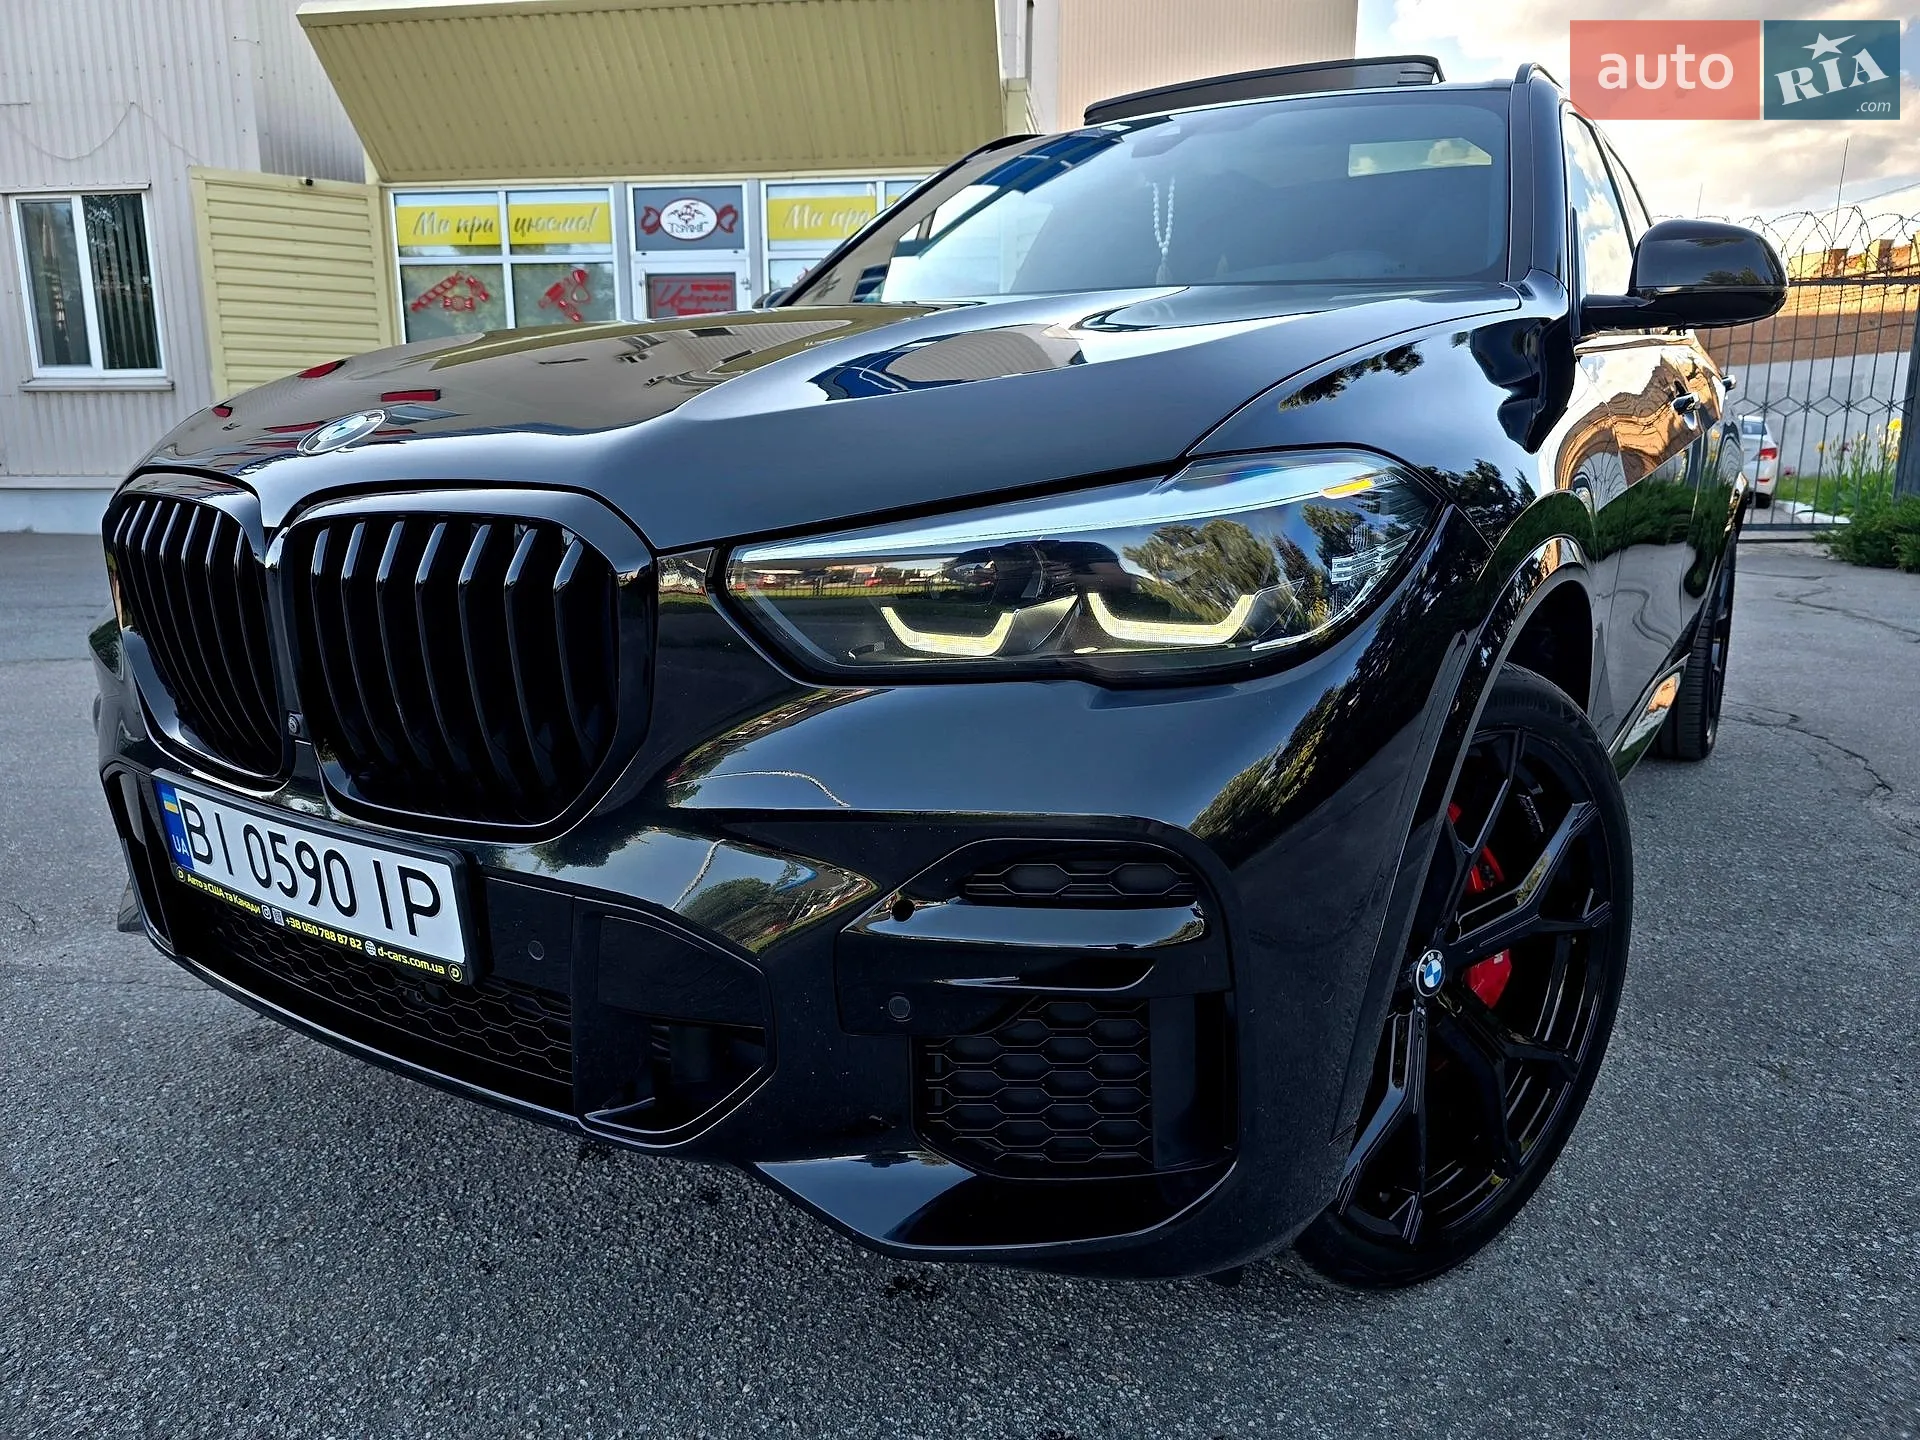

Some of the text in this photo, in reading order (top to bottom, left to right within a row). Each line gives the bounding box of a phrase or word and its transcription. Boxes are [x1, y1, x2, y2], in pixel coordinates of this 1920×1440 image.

[172, 834, 190, 857] UA
[179, 798, 441, 938] BI 0590 IP
[187, 874, 203, 888] Авто
[207, 883, 226, 899] США
[224, 891, 234, 902] та
[233, 893, 261, 914] Канади
[286, 916, 302, 930] +38
[301, 921, 319, 936] 050
[319, 927, 337, 942] 788
[336, 933, 348, 946] 87
[349, 937, 363, 951] 82
[377, 946, 445, 975] d-cars.com.ua
